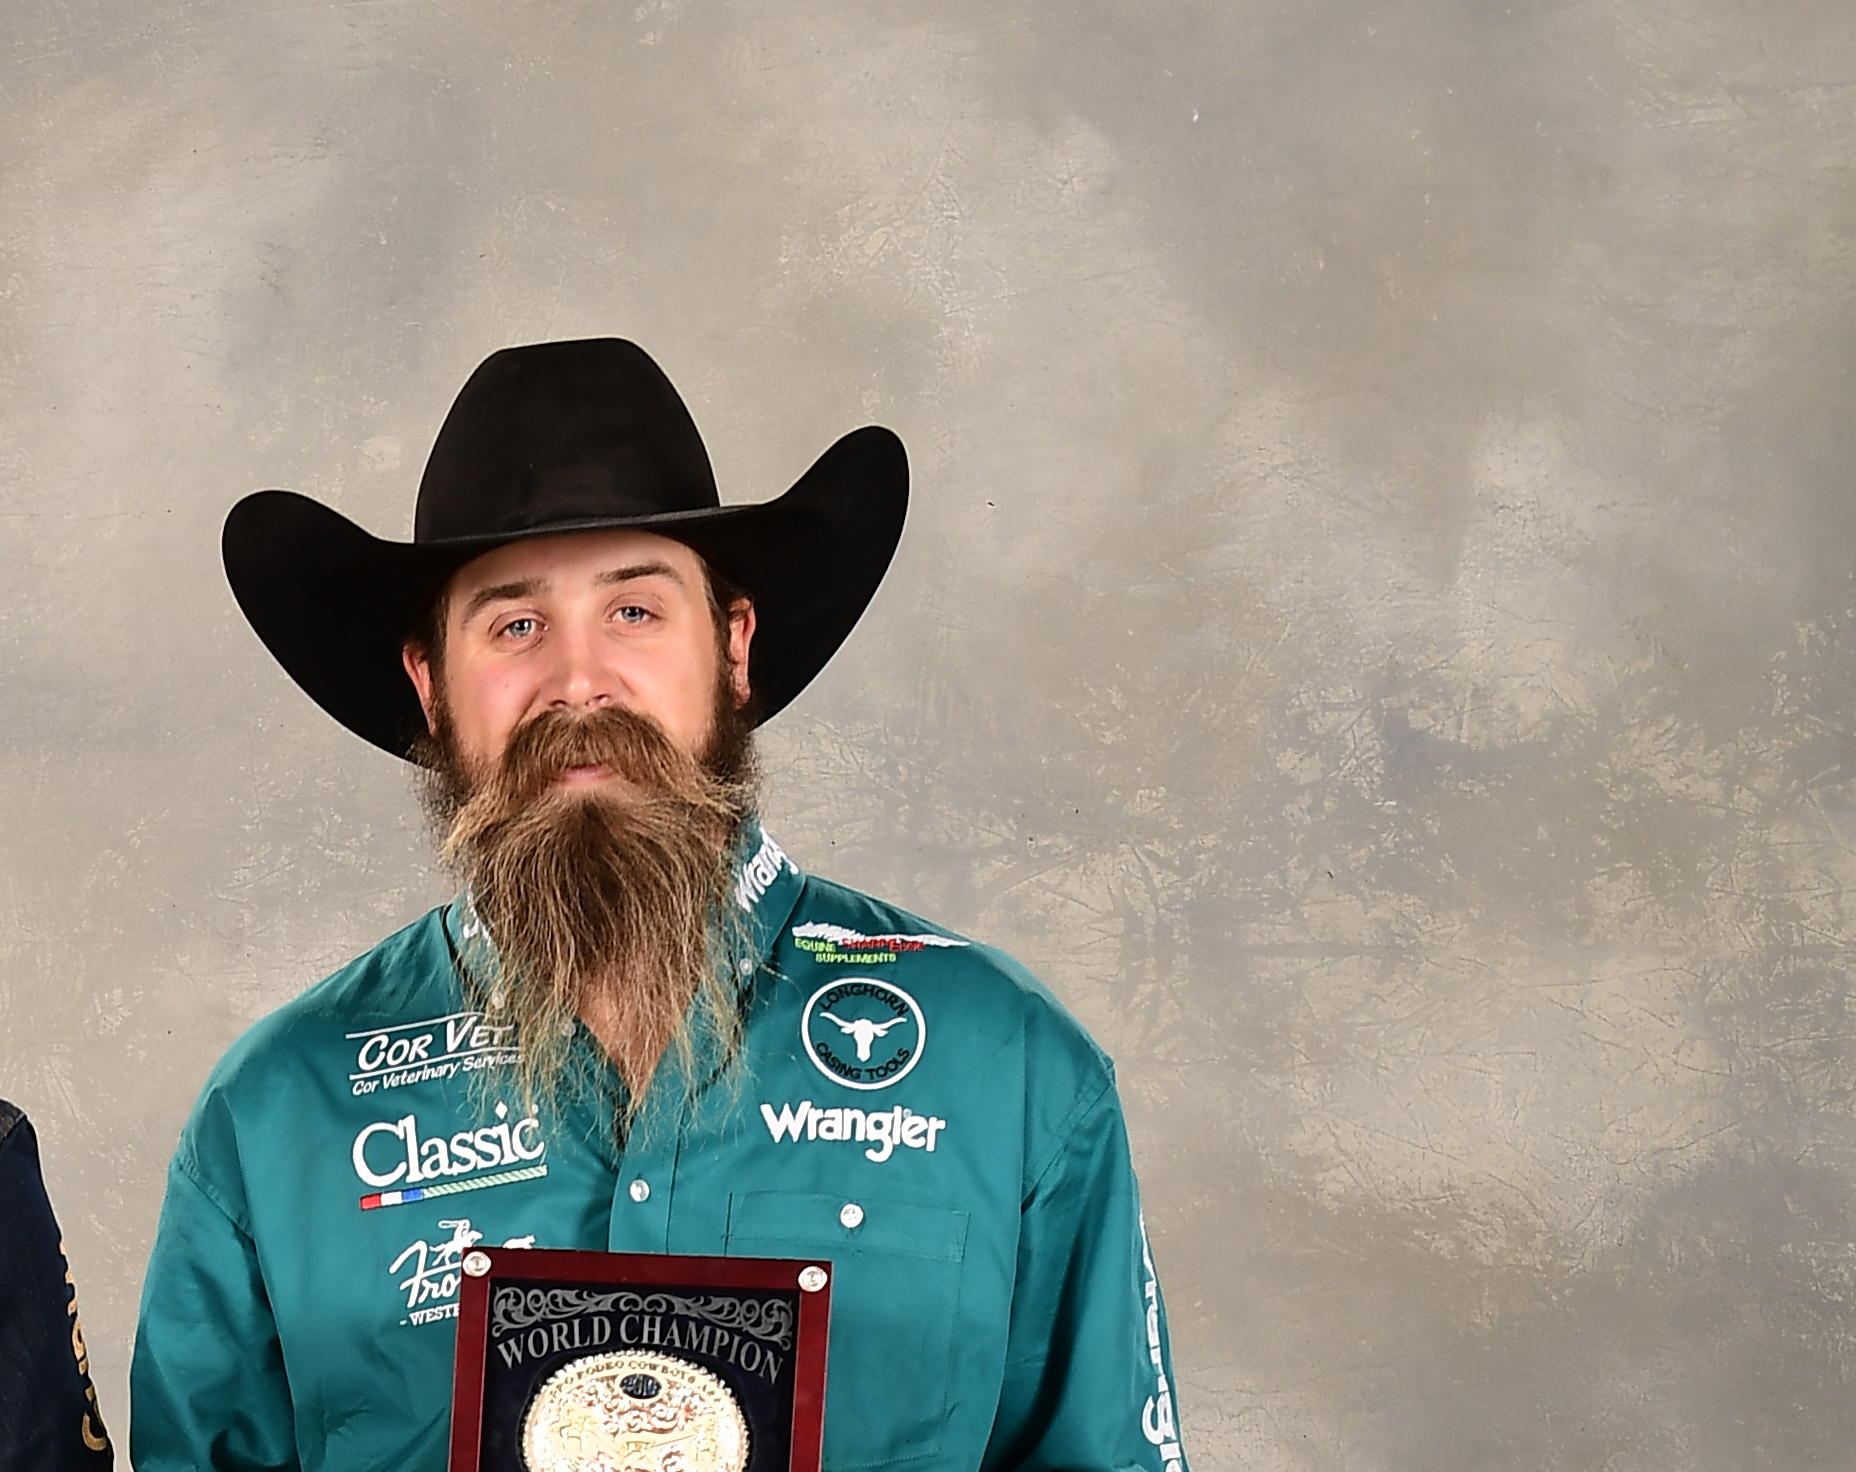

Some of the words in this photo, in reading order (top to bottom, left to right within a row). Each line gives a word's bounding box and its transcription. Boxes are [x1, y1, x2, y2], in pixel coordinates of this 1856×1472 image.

[794, 938, 836, 953] EQUINE
[815, 952, 897, 964] SUPPLEMENTS
[818, 984, 910, 1016] LONGHORN
[357, 1034, 434, 1071] COR
[816, 1042, 861, 1079] CASING
[865, 1047, 910, 1079] TOOLS
[352, 1080, 379, 1096] Cor
[382, 1064, 461, 1089] Veterinary
[462, 1051, 524, 1072] Services
[352, 1101, 546, 1188] Classic
[760, 1100, 947, 1162] Wrangler
[409, 1303, 460, 1327] WESTE
[496, 1315, 611, 1370] WORLD
[619, 1314, 784, 1386] CHAMPION
